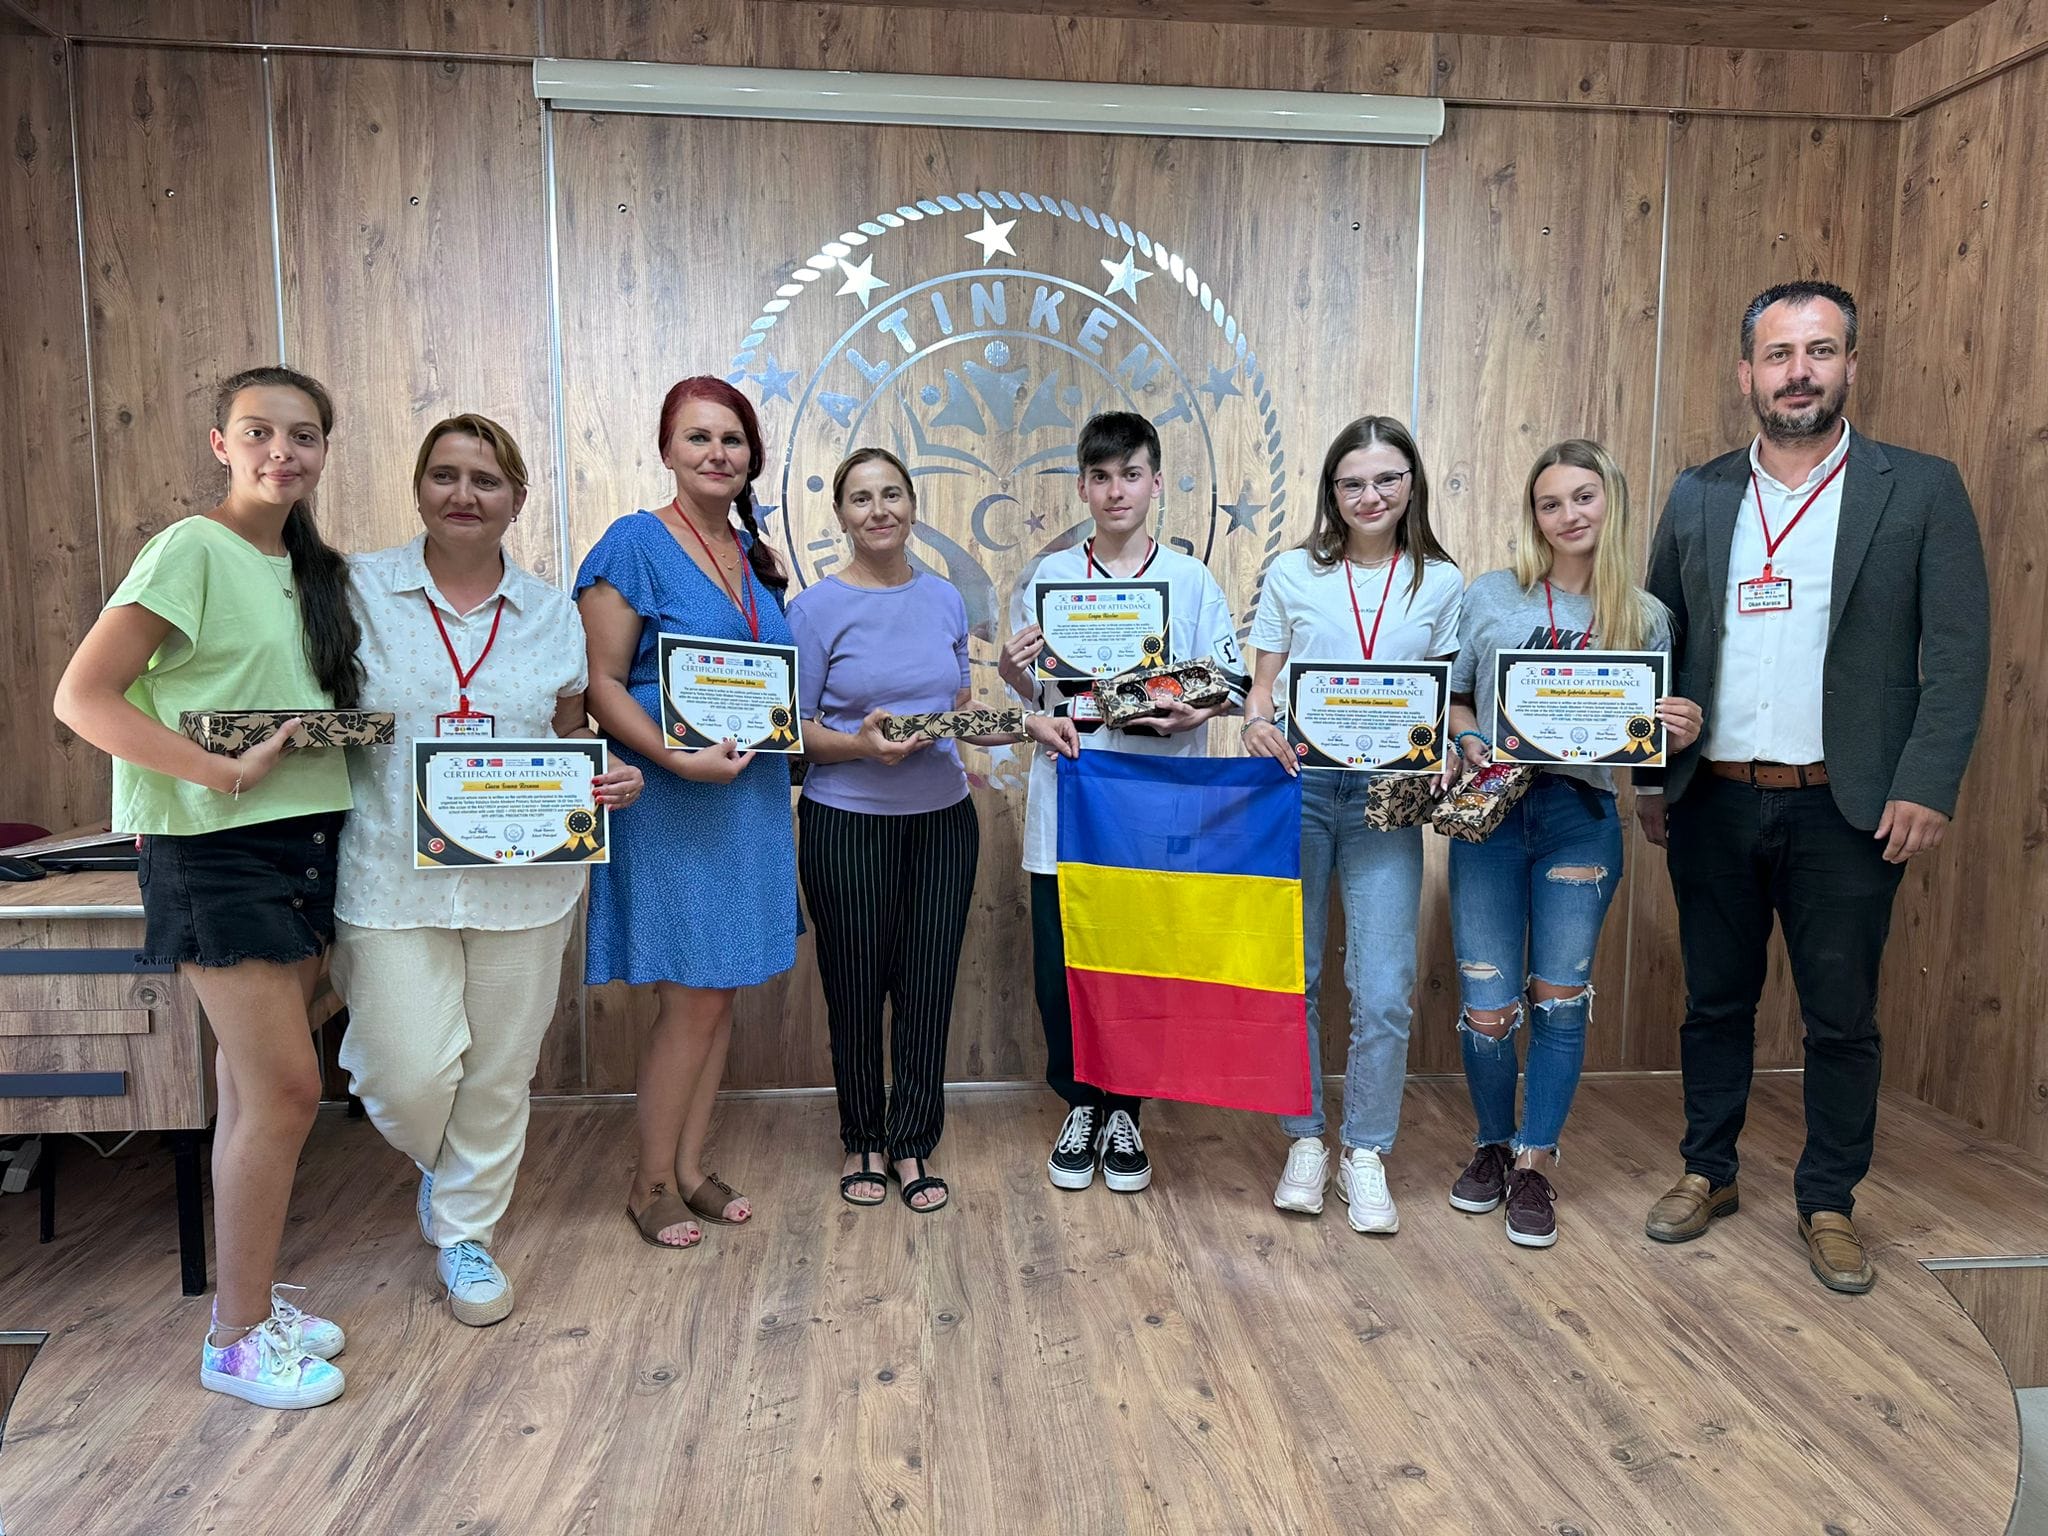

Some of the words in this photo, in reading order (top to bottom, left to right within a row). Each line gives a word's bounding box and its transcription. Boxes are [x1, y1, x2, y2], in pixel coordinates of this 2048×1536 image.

[817, 280, 1194, 430] ALTINKENT
[682, 664, 724, 672] CERTIFICATE
[736, 669, 777, 678] ATTENDANCE
